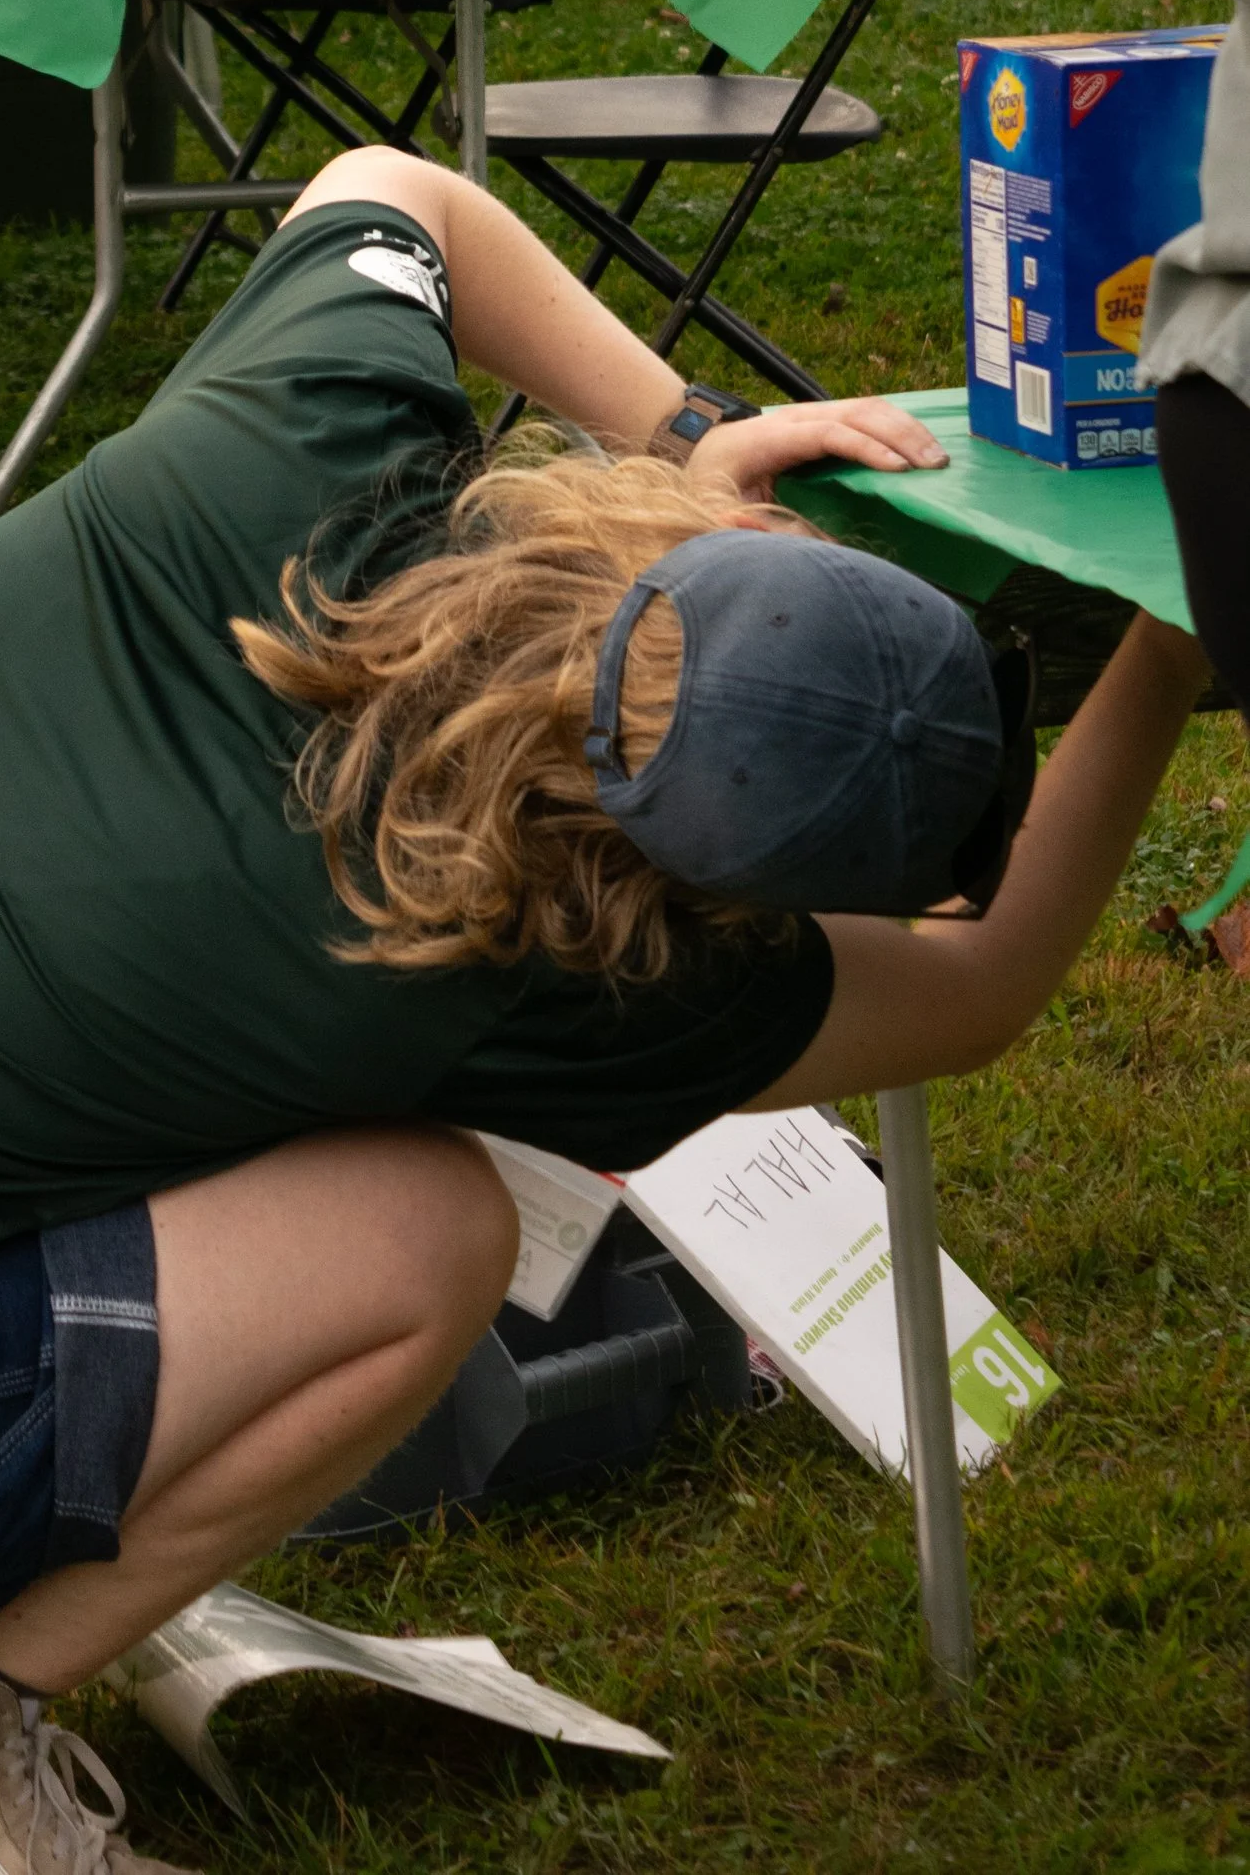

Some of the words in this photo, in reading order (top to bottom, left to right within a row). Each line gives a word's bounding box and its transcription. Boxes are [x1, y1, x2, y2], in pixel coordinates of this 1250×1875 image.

[992, 92, 1021, 114] Honey
[1075, 75, 1103, 106] NABISCO
[998, 113, 1019, 131] Maid
[1104, 298, 1145, 322] Ho
[1096, 367, 1125, 392] NO
[849, 1222, 884, 1257] Diameter
[837, 1263, 888, 1313] Bamboo
[793, 1306, 845, 1355] Skewers
[972, 1328, 1045, 1407] 16
